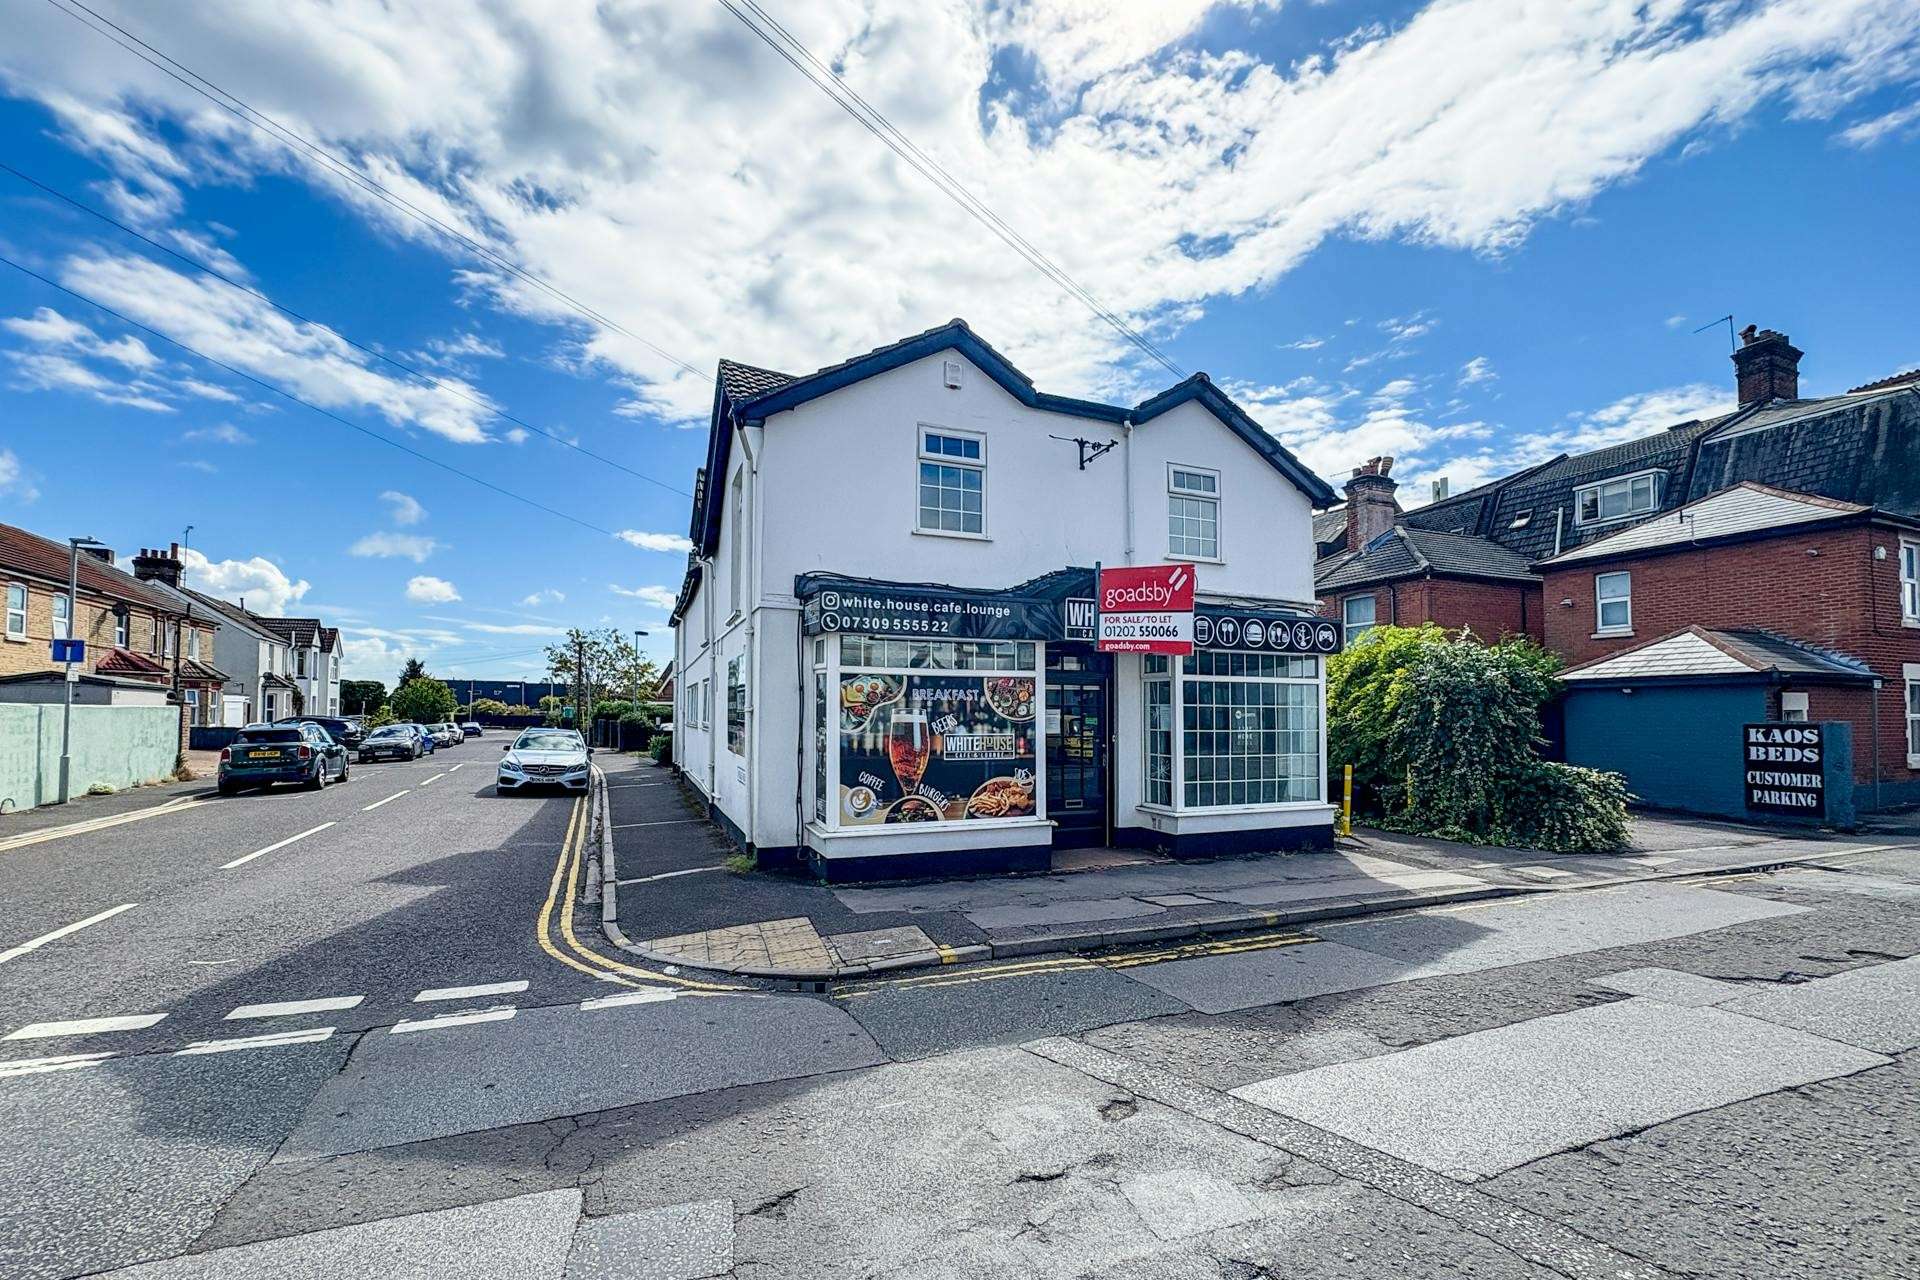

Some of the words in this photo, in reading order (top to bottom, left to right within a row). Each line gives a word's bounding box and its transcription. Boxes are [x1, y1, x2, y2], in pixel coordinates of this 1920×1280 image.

[1105, 581, 1173, 609] goadsby
[842, 597, 1011, 618] white.house.cafe.lounge
[1069, 602, 1095, 627] WH
[1104, 616, 1121, 624] FOR
[1159, 615, 1172, 623] LET
[1082, 629, 1094, 638] CA
[1104, 626, 1136, 637] 01202
[1139, 625, 1179, 637] 550066
[1105, 642, 1150, 651] goadsby.com
[912, 688, 979, 701] BREAKFAST
[931, 713, 958, 735] BEERS
[1748, 728, 1819, 744] KAOS
[1748, 746, 1820, 763] BEDS
[858, 771, 886, 792] COFFEE
[1747, 771, 1823, 788] CUSTOMER
[918, 783, 951, 812] BURGERS
[1752, 789, 1817, 807] PARKING
